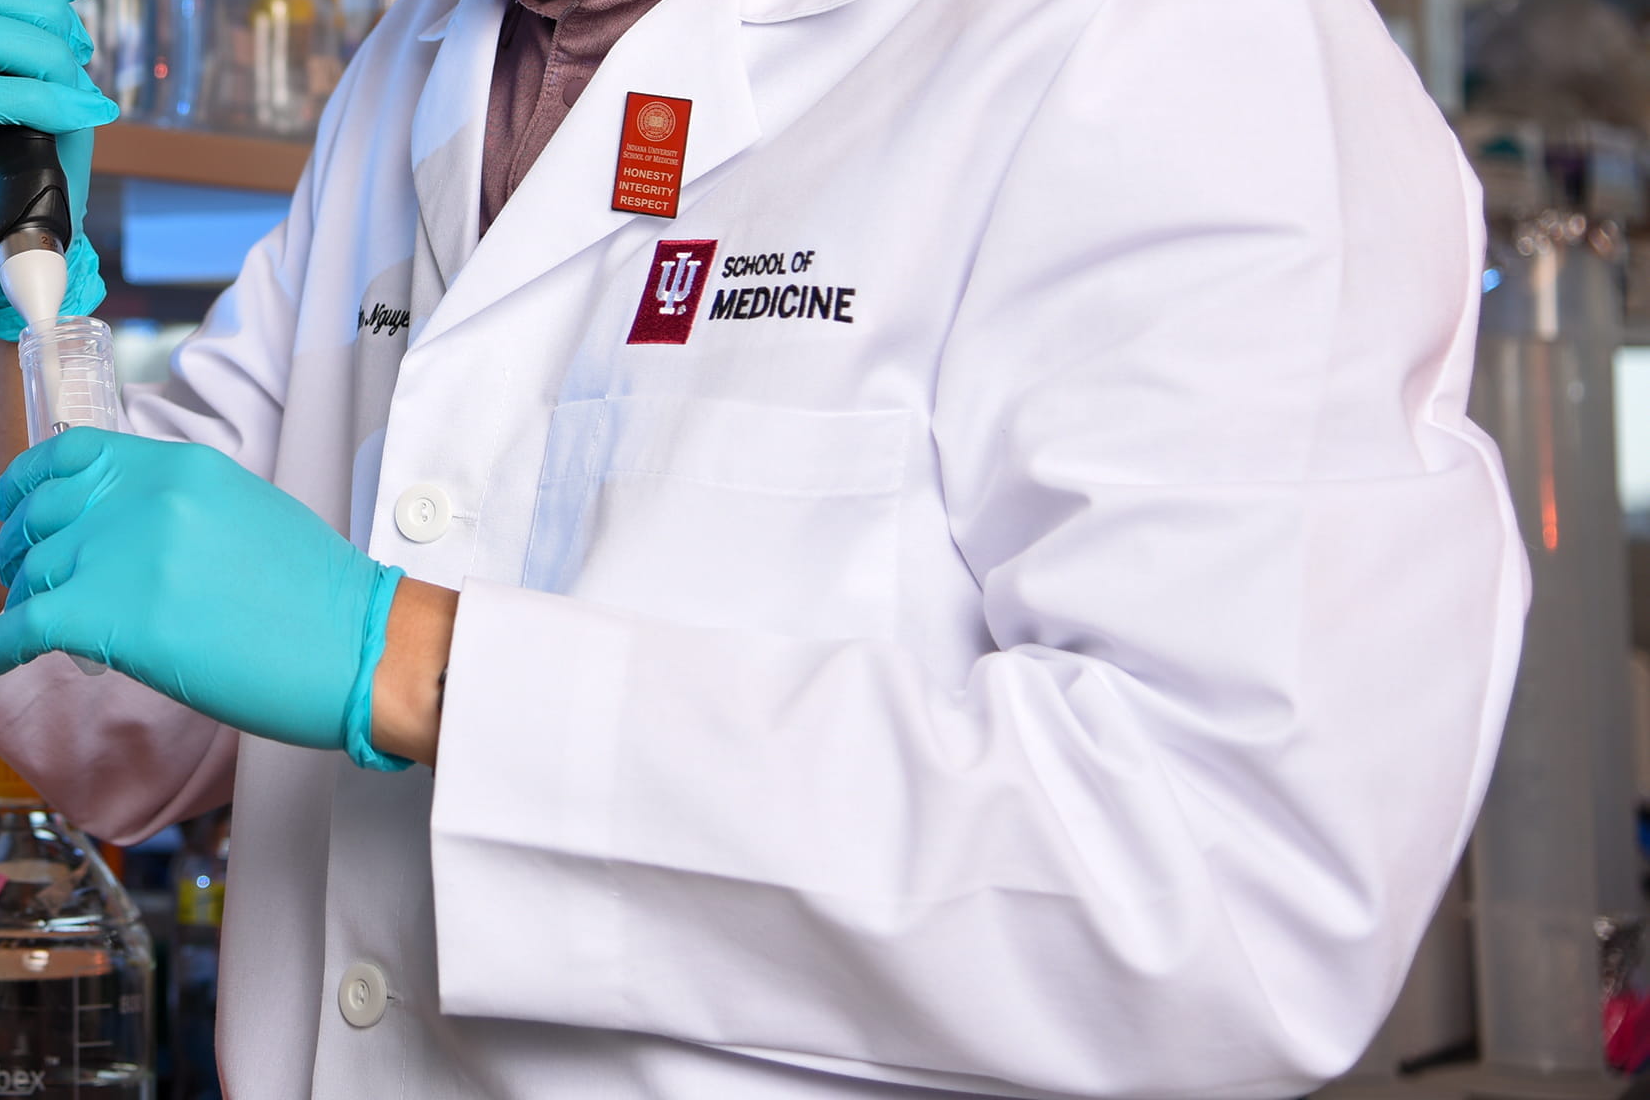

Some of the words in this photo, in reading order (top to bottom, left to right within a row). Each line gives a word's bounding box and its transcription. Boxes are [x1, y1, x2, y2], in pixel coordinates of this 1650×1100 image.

[623, 167, 674, 182] HONESTY
[619, 181, 675, 197] INTEGRITY
[620, 195, 669, 211] RESPECT
[721, 253, 786, 278] SCHOOL
[791, 250, 816, 273] OF
[709, 284, 856, 324] MEDICINE
